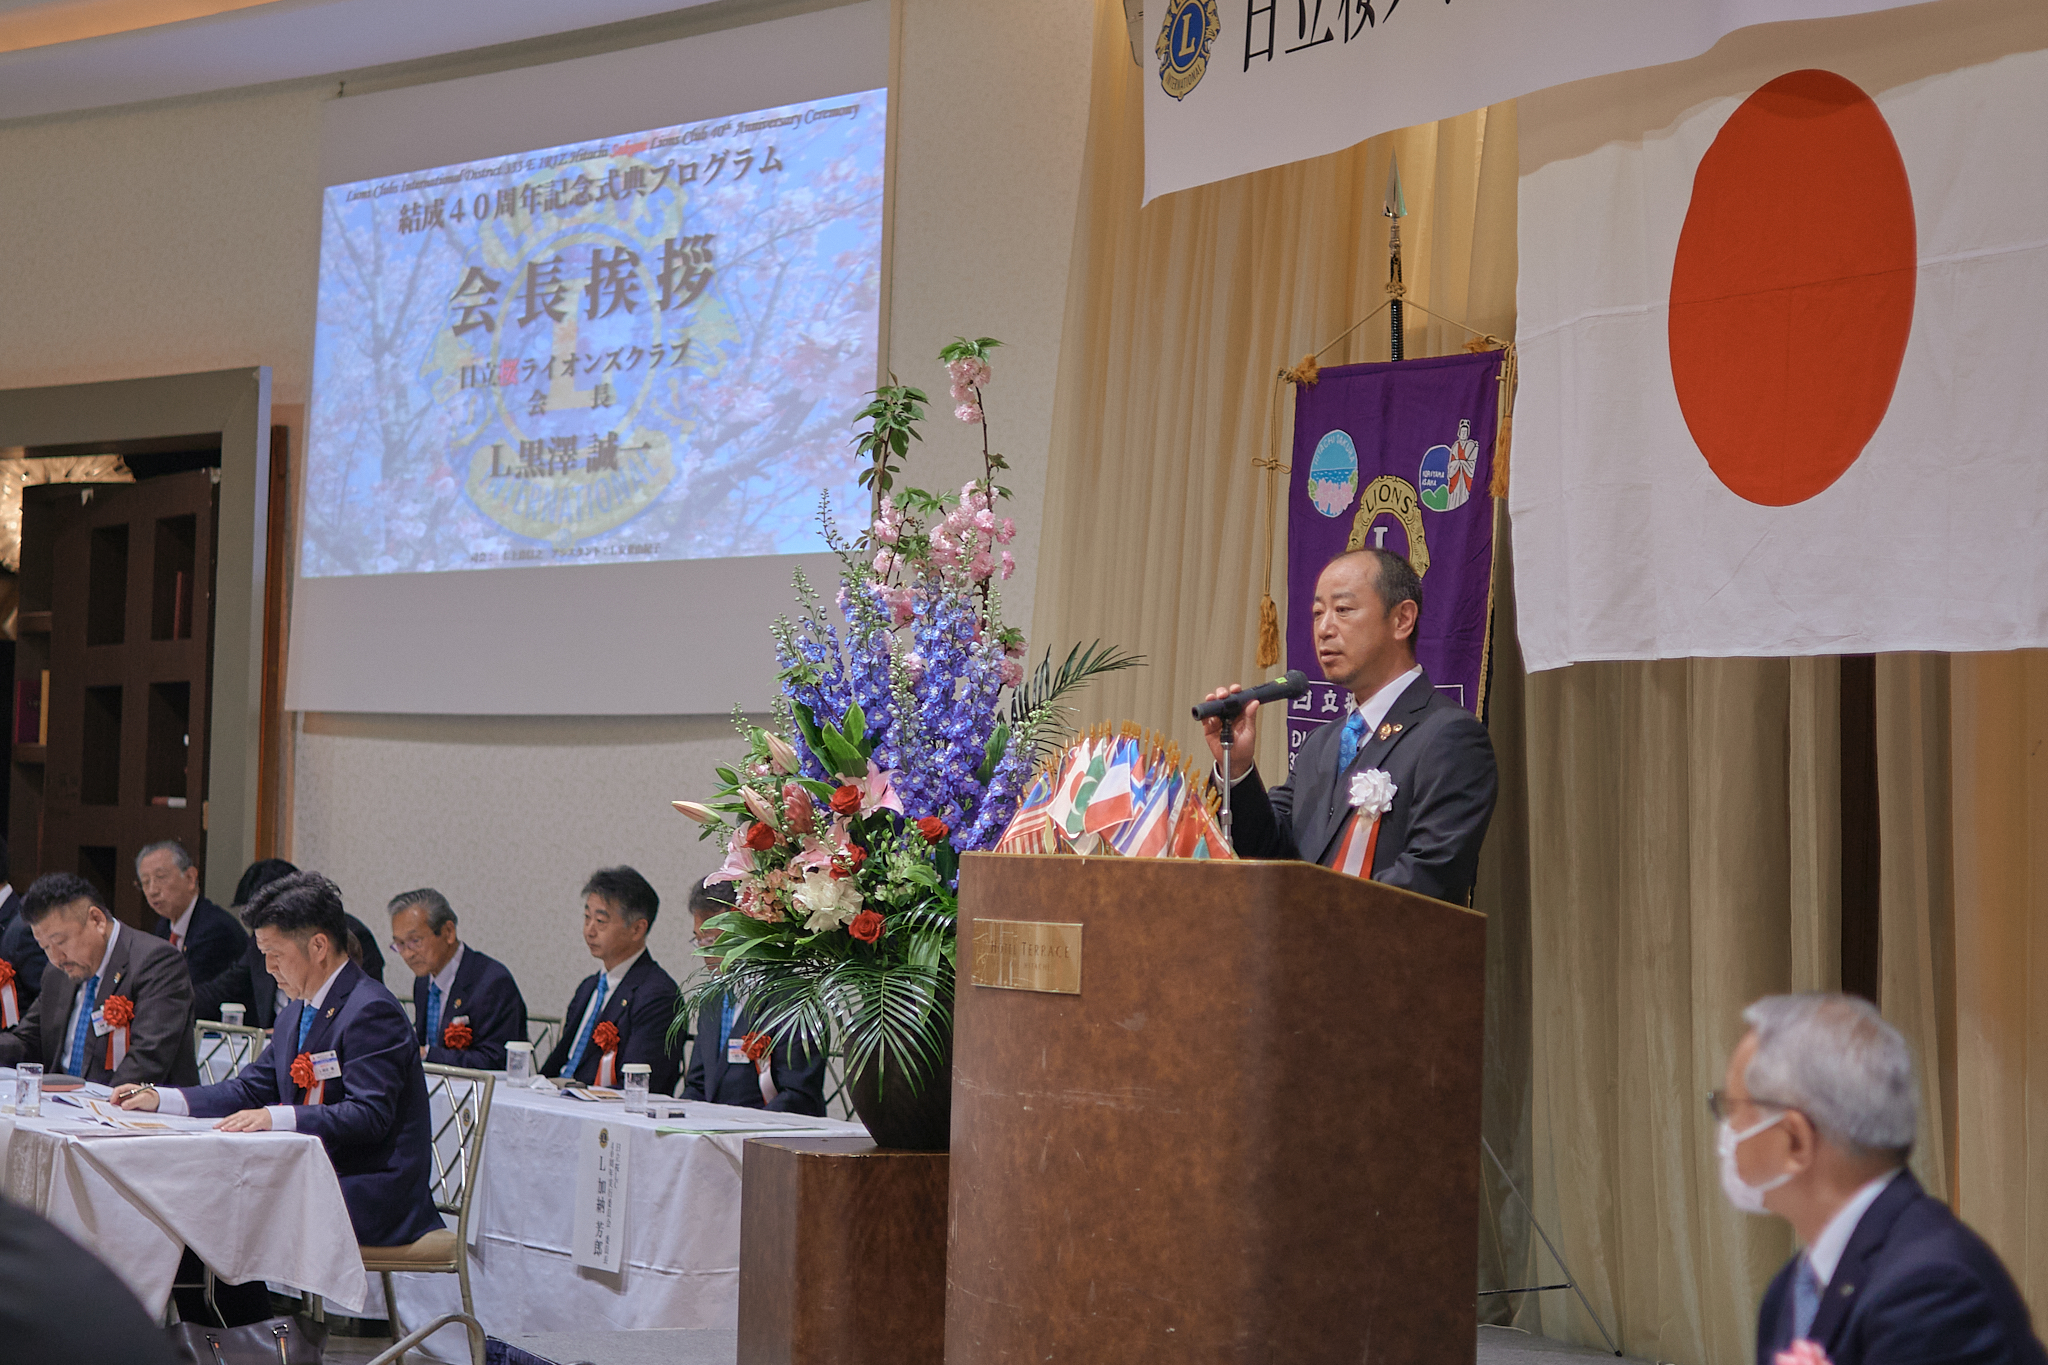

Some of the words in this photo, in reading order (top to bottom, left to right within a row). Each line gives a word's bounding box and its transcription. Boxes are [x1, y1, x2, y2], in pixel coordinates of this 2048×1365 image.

[1178, 12, 1197, 57] L
[1165, 63, 1204, 91] INTERNATIONAL
[732, 113, 803, 138] Anniversary
[803, 104, 860, 126] Ceremony
[450, 233, 717, 338] 会長挨拶
[460, 338, 692, 390] 日立桜ライオンズクラブ
[1313, 435, 1336, 466] HITACHI
[1365, 484, 1413, 515] LIONS
[990, 940, 1017, 956] HOTEL
[1022, 941, 1071, 960] TERRACE
